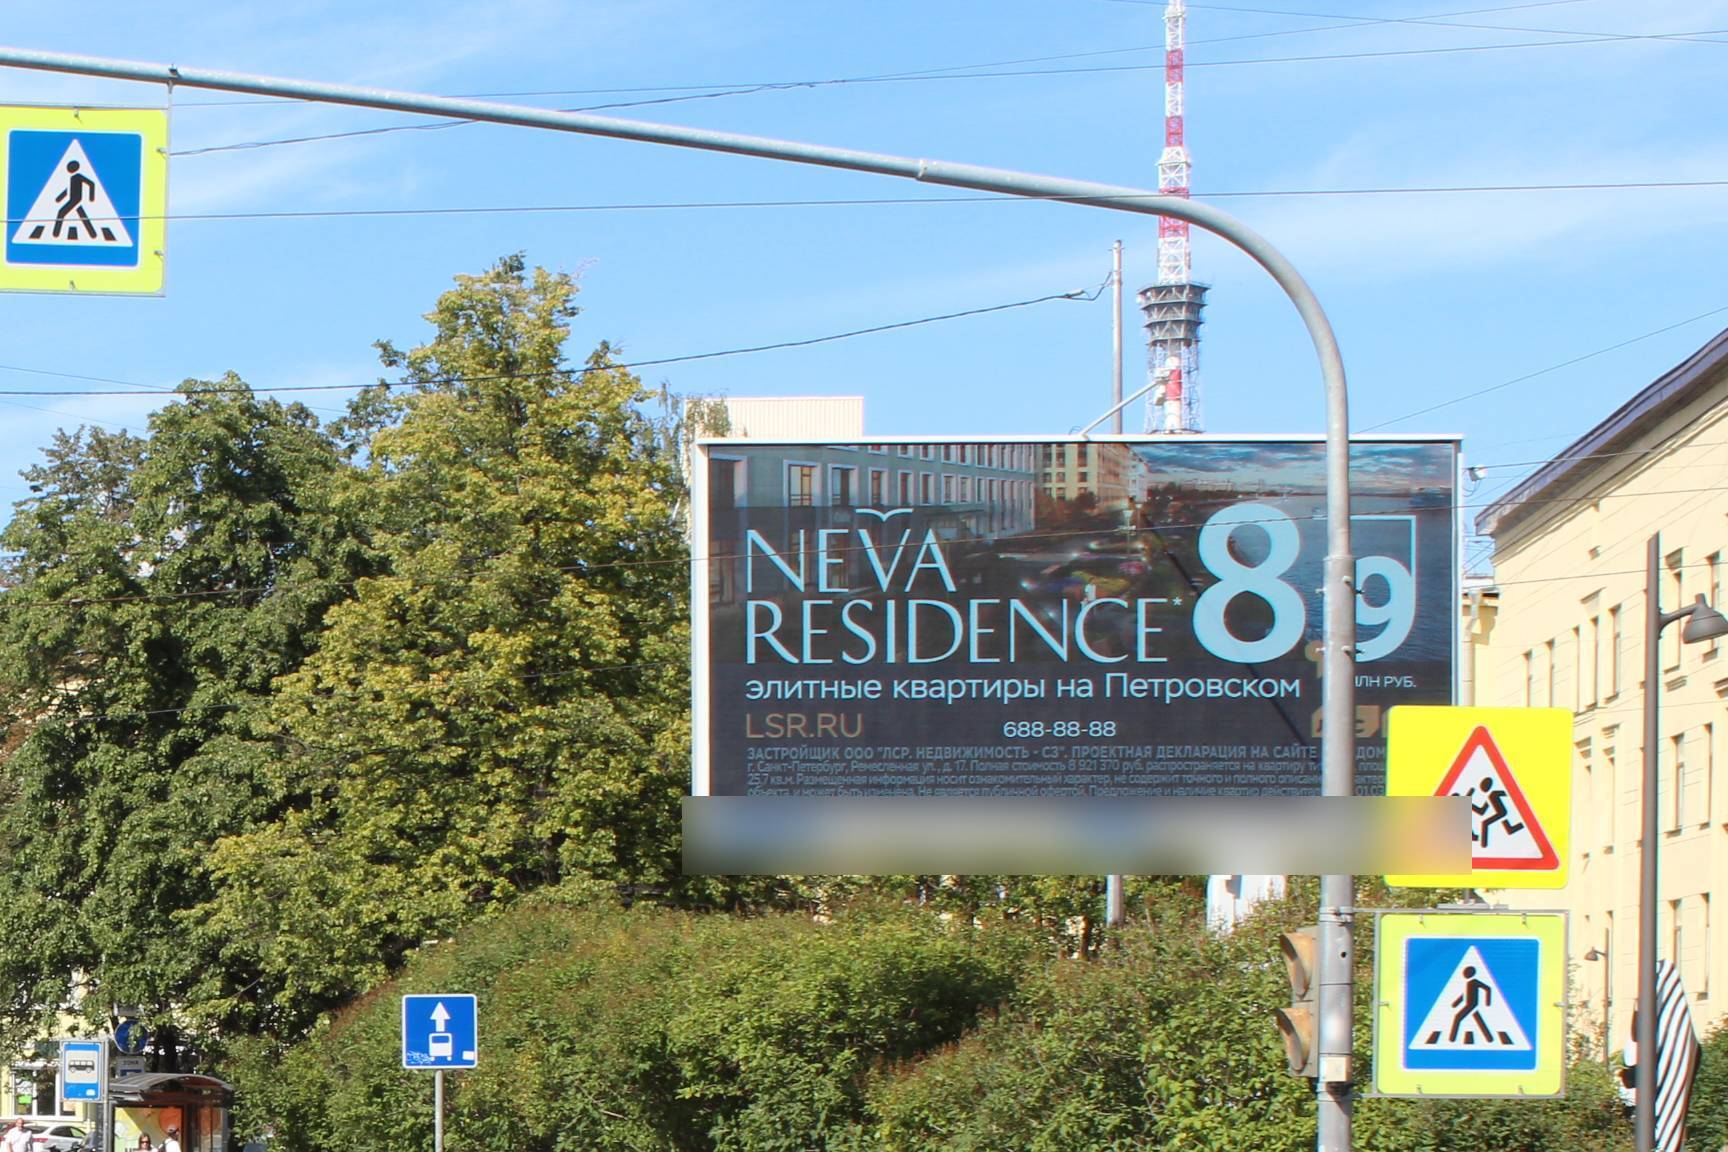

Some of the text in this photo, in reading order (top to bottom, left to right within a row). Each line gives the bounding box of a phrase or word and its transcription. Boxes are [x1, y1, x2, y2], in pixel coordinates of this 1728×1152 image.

[747, 528, 956, 592] NEVA
[745, 673, 1300, 705] элитные квартиры на Петровском
[1384, 675, 1416, 688] РУБ.
[746, 713, 862, 738] LSR.RU
[1003, 722, 1116, 738] 688-88-88
[747, 745, 840, 761] ЗАСТРОЙЩИК
[844, 747, 874, 760] ООО
[915, 747, 1030, 761] НЕДВИЖИМОСТЬ
[1072, 746, 1152, 759] ПРОЕКТНАЯ
[1156, 746, 1247, 761] ДЕКЛАРАЦИЯ
[1250, 746, 1269, 758] НА
[1273, 743, 1318, 759] САЙТЕ
